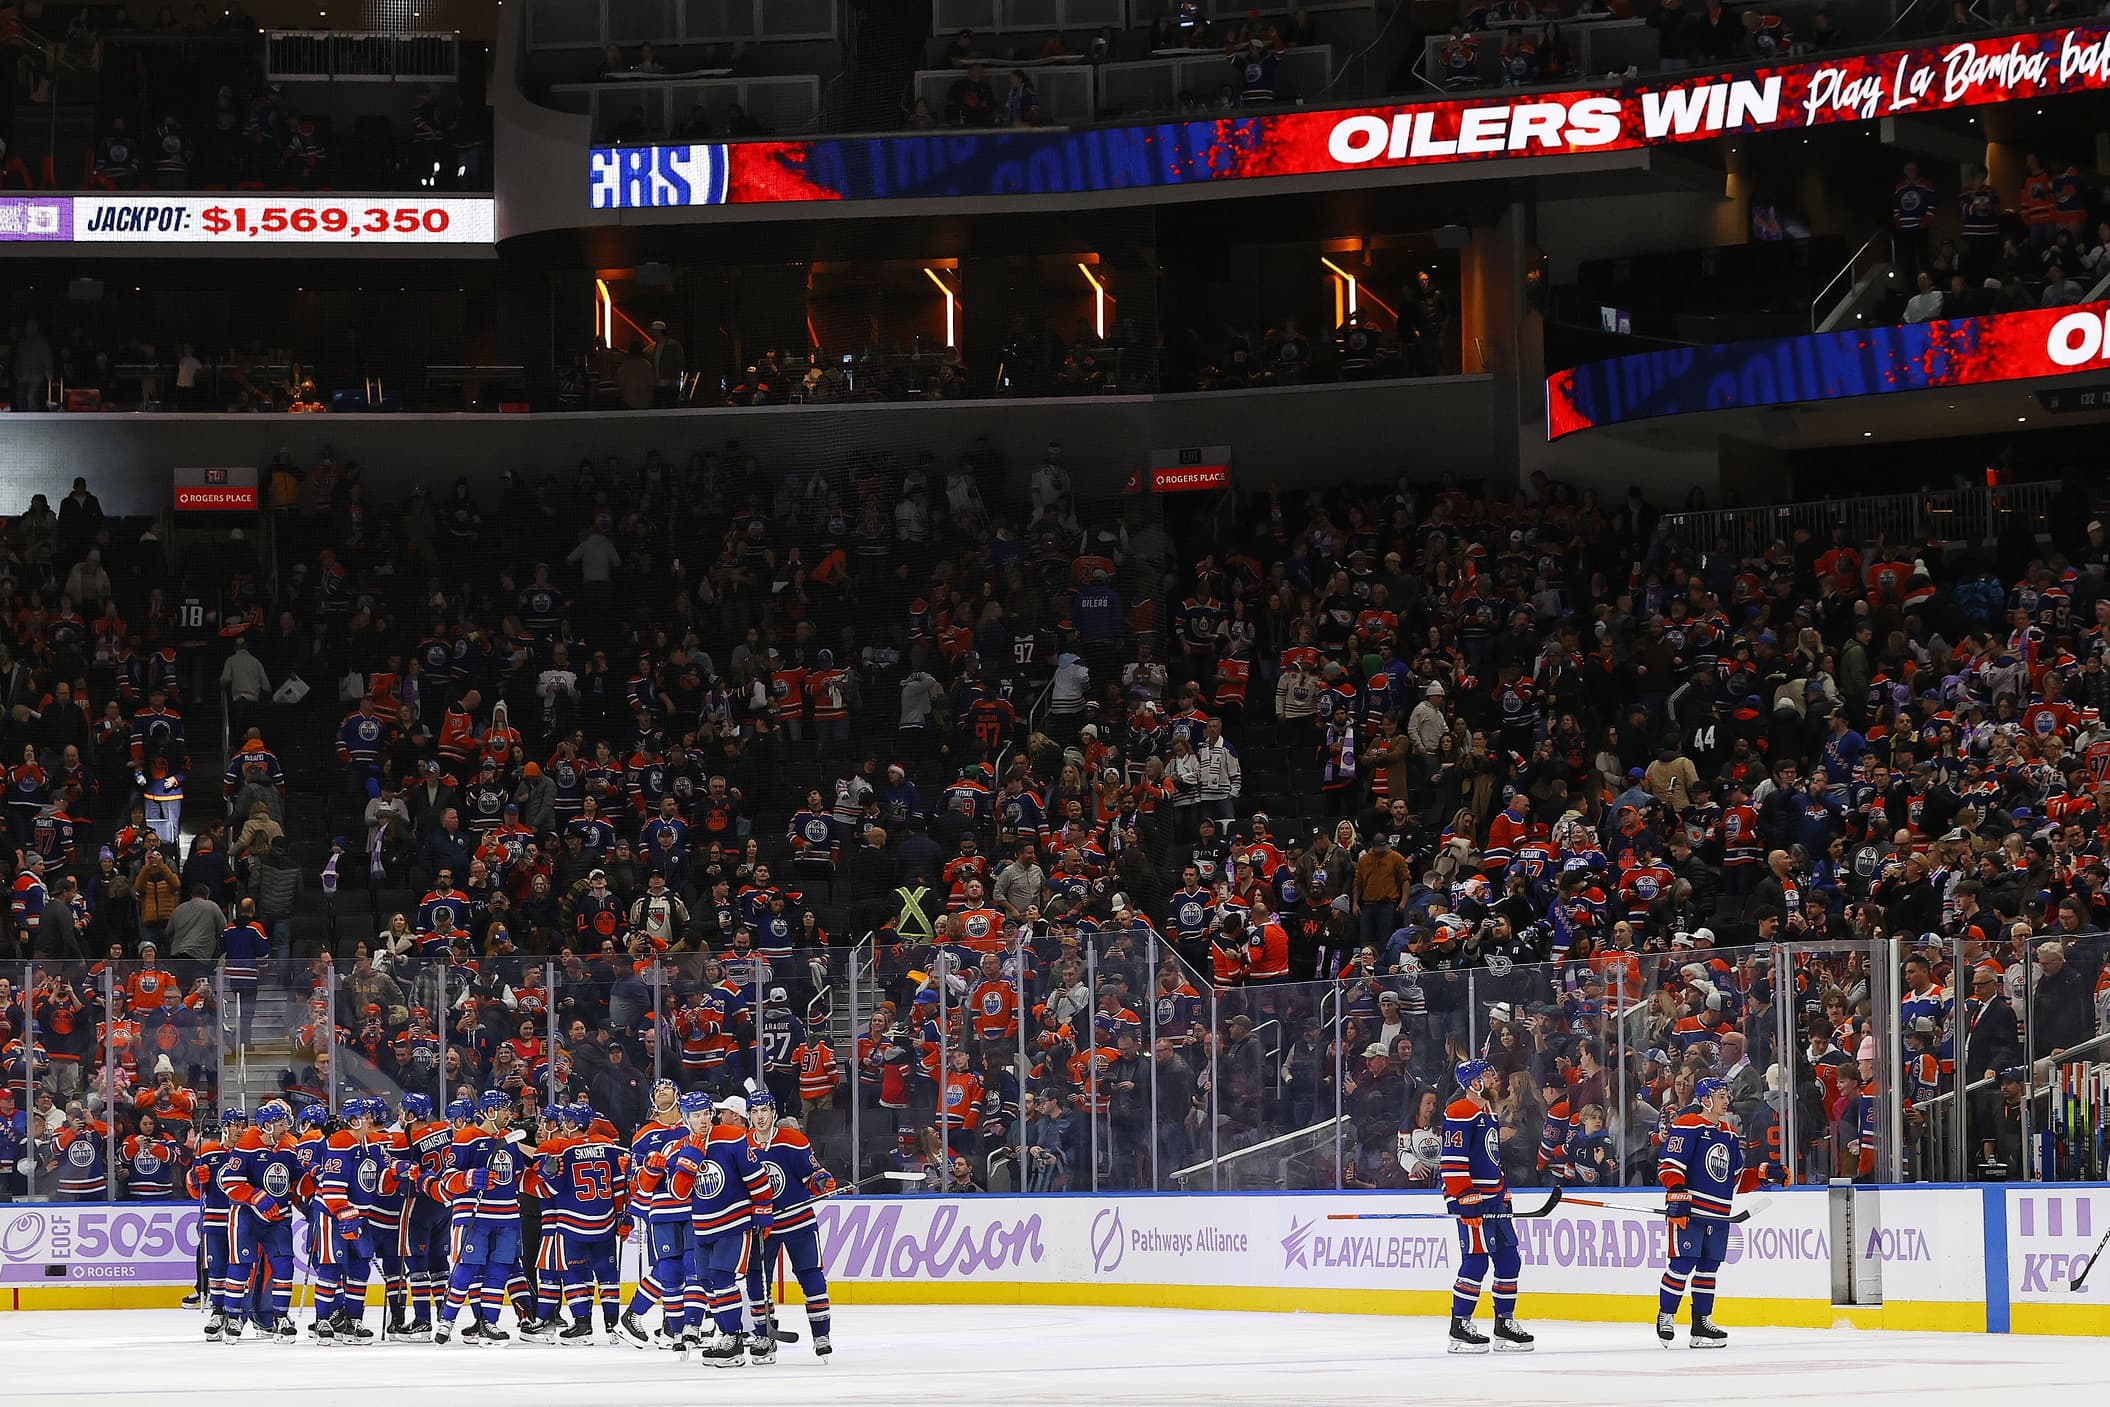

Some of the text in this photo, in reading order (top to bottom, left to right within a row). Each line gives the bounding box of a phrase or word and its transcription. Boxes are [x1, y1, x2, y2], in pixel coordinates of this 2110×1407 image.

[1803, 68, 1883, 126] Play
[1888, 55, 1935, 110] La
[1943, 42, 2050, 103] Bamba,
[1327, 76, 1782, 163] OILERS WIN
[87, 205, 450, 237] JACKPOT: $1,569,350
[1165, 472, 1225, 483] ROGERS PLACE
[190, 494, 252, 502] ROGERS PLACE
[1081, 599, 1109, 608] OILERS
[180, 605, 203, 627] 18
[1014, 642, 1034, 664] 97
[975, 722, 1000, 746] 97
[1694, 725, 1715, 751] 44
[954, 790, 973, 798] HYMAN
[764, 1022, 790, 1031] ARAQUE
[763, 1033, 792, 1059] 27
[801, 1054, 821, 1073] 97
[1444, 1131, 1463, 1148] 14
[1666, 1136, 1684, 1152] 51
[574, 1147, 606, 1160] SKINNER
[325, 1159, 342, 1174] 42
[572, 1161, 612, 1202] 53
[51, 1214, 71, 1259] EOCF
[816, 1205, 1045, 1278] Molson
[1131, 1227, 1248, 1257] Pathways Alliance
[1514, 1218, 1666, 1268] ATORADE
[1747, 1226, 1830, 1260] KONICA
[1312, 1236, 1449, 1269] PLAYALBERTA
[87, 1266, 136, 1277] ROGERS
[2020, 1253, 2091, 1293] KFC
